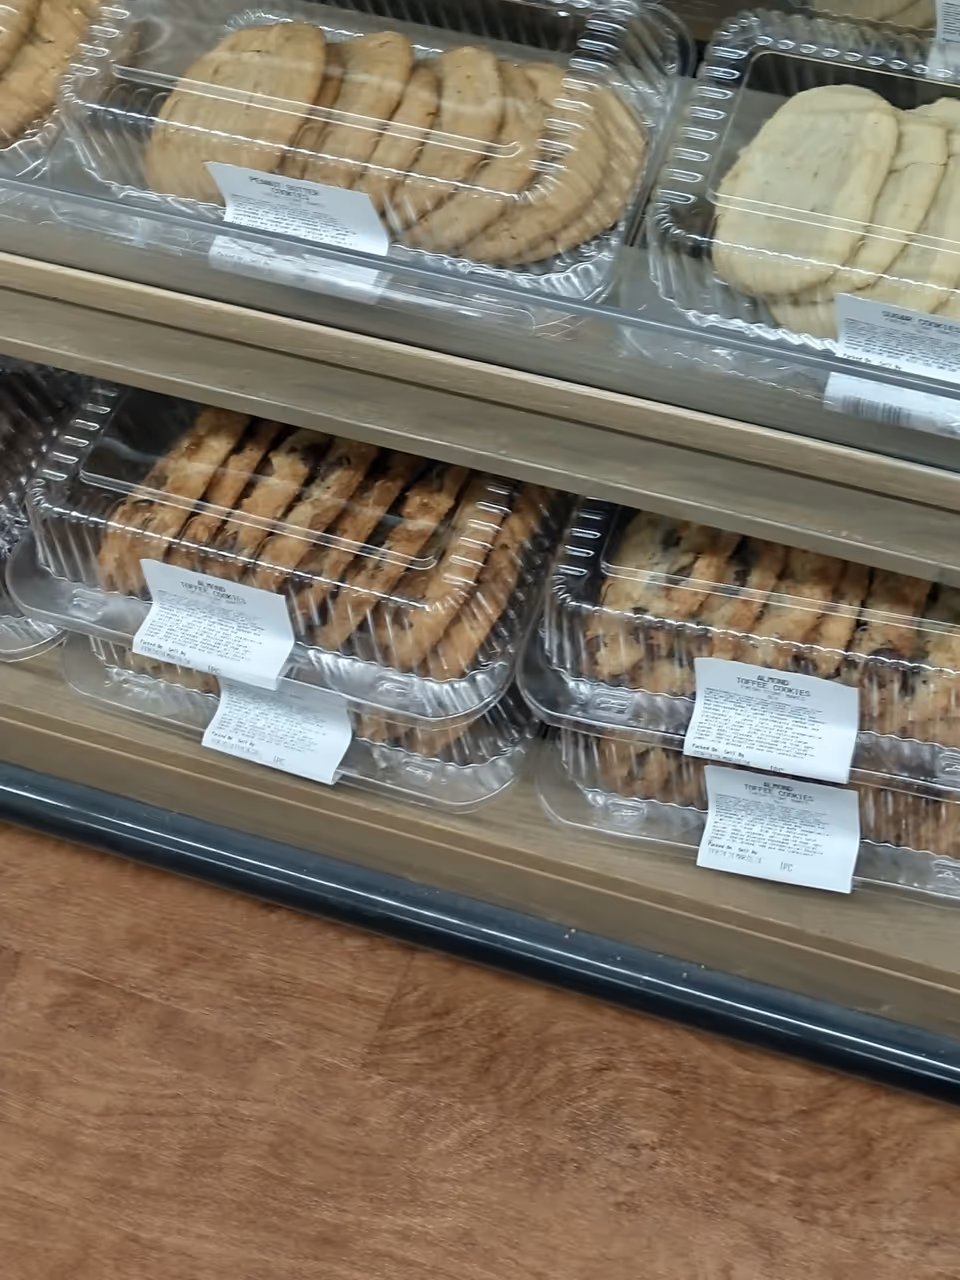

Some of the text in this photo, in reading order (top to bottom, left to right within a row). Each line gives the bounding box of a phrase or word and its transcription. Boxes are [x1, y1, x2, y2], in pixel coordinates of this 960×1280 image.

[249, 176, 319, 196] PEANUT BUTTER
[271, 187, 309, 201] COOKIES
[882, 310, 960, 333] SUGAR COOKIES
[180, 582, 247, 605] TOFFEE COOKIES
[197, 580, 226, 592] ALMOND
[736, 677, 811, 697] TOFFEE COOKIES
[756, 674, 789, 686] ALMOND
[744, 783, 814, 802] TOFFEE COOKIES
[763, 781, 793, 792] ALMOND
